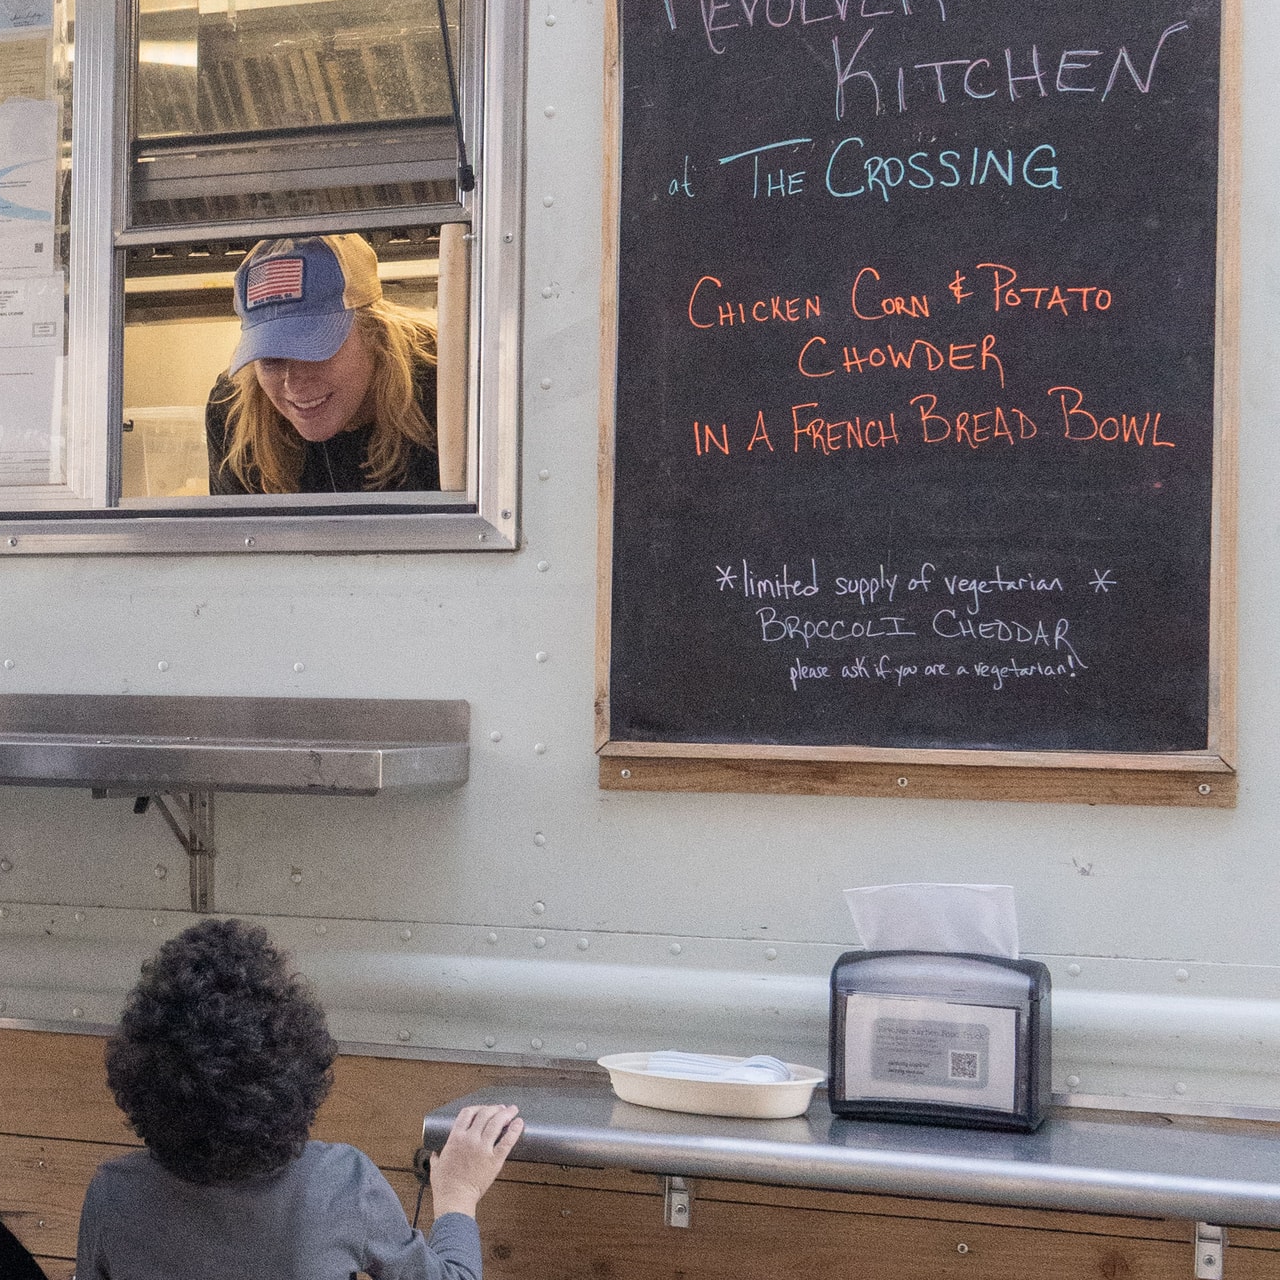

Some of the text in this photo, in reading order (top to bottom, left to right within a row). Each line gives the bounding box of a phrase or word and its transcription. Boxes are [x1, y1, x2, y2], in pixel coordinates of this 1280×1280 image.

[832, 21, 1190, 120] KITCHEN
[667, 137, 1063, 202] at THE CROSSING
[688, 276, 821, 329] CHICKEN
[798, 333, 1005, 388] CHOWDER
[693, 420, 730, 456] IN
[747, 410, 774, 453] A
[1048, 386, 1176, 448] BOWL
[836, 564, 898, 605] supply
[908, 563, 935, 592] of
[945, 565, 1064, 615] vegetarian
[790, 658, 830, 691] please
[841, 656, 869, 678] ask
[875, 655, 891, 679] if
[894, 663, 918, 685] you
[924, 663, 950, 678] are
[956, 664, 970, 677] a
